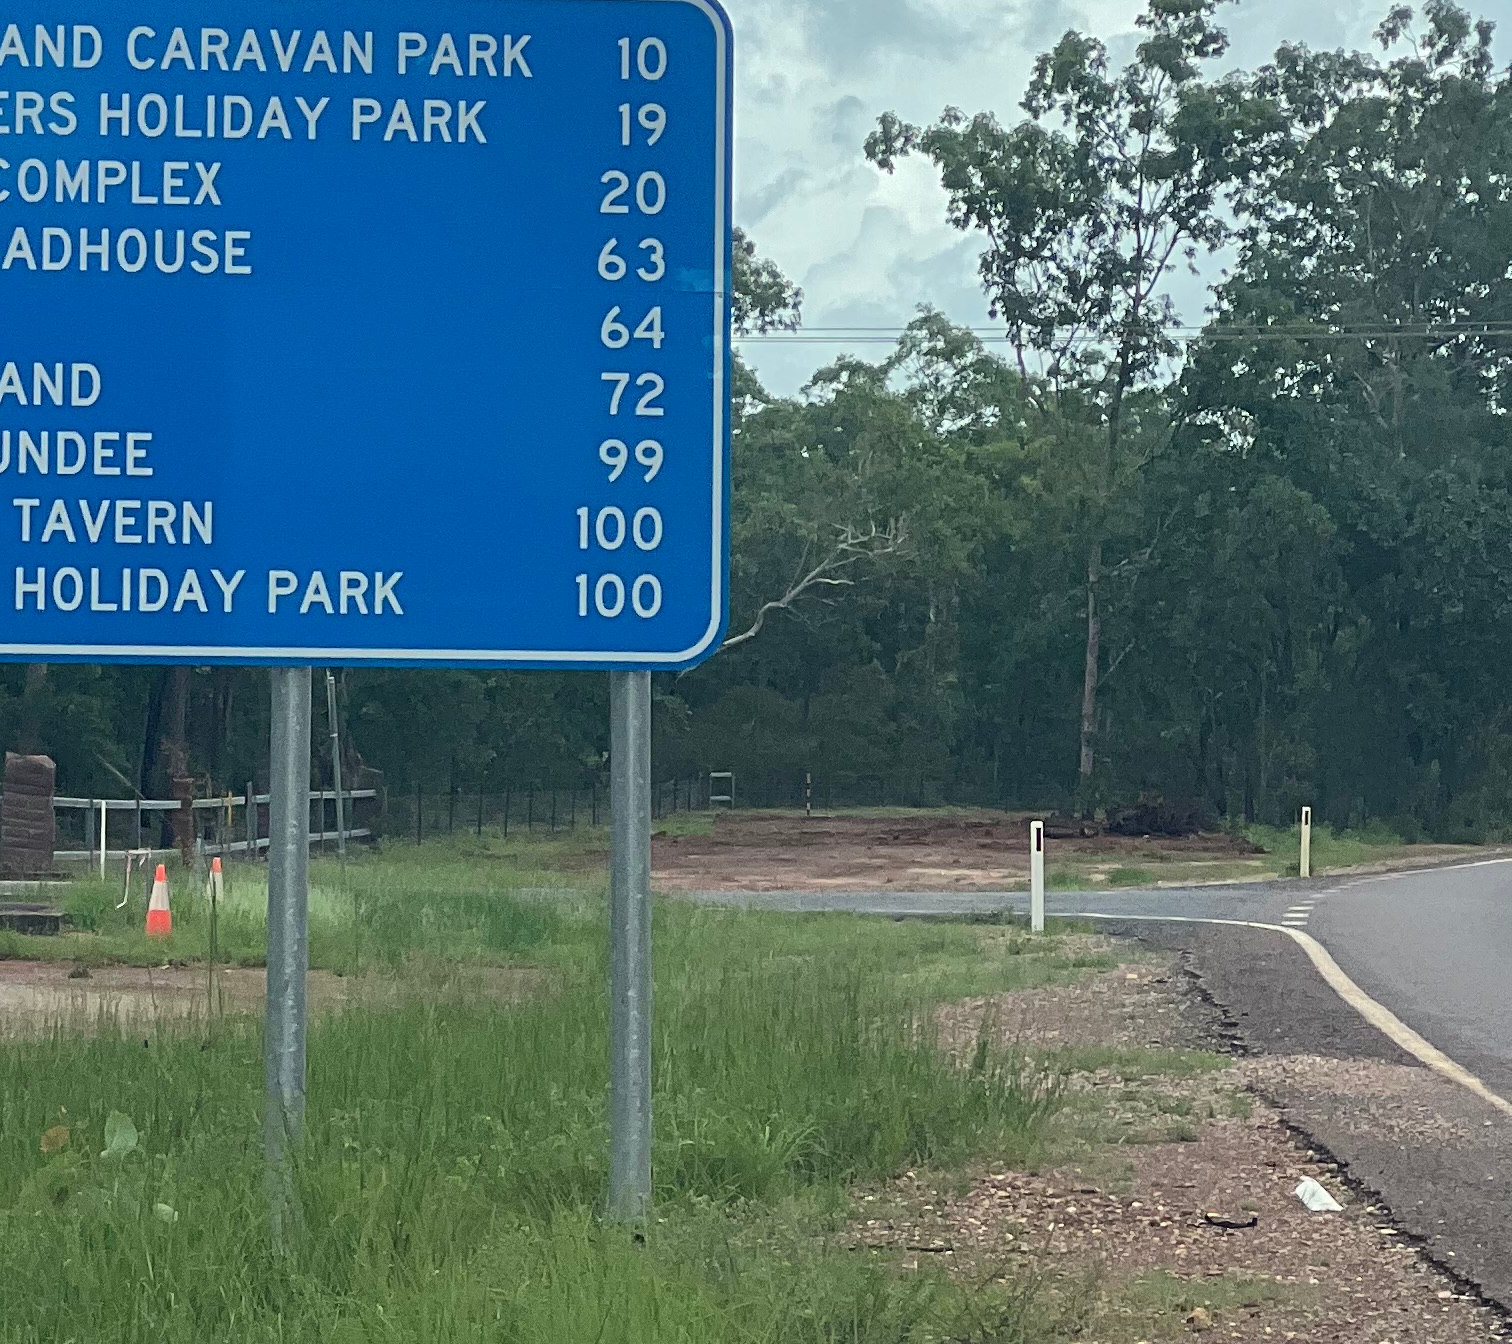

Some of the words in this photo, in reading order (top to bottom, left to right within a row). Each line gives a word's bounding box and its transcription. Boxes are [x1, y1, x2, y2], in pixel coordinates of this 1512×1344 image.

[127, 26, 373, 74] CARAVAN
[398, 32, 533, 78] PARK
[617, 37, 667, 81] 10
[99, 93, 330, 140] HOLIDAY
[352, 98, 487, 144] PARK
[619, 103, 667, 146] 19
[599, 170, 666, 215] 20
[597, 238, 665, 282] 63
[601, 305, 665, 349] 64
[601, 372, 664, 416] 72
[599, 439, 664, 483] 99
[12, 498, 213, 545] TAVERN
[576, 506, 663, 551] 100
[15, 566, 245, 613] HOLIDAY
[268, 569, 404, 615] PARK
[575, 573, 662, 618] 100
